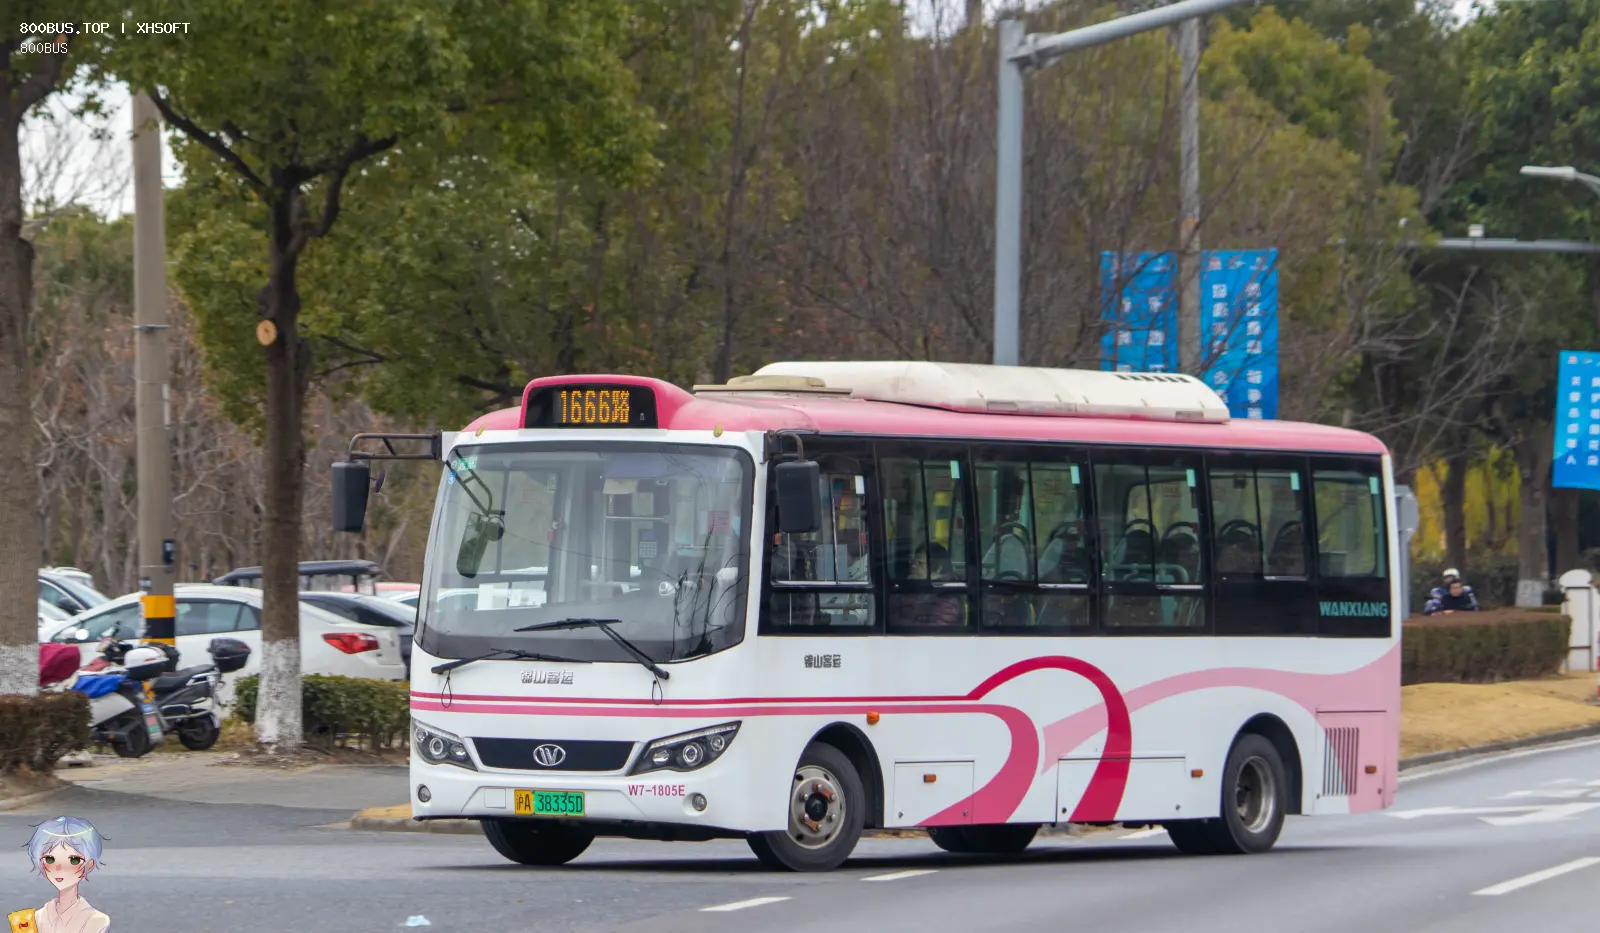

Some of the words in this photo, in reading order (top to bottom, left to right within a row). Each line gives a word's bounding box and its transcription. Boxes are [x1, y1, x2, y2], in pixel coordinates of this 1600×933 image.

[560, 390, 630, 423] 1666路
[1319, 601, 1389, 617] WANXIANG
[628, 784, 686, 797] W7-1805E
